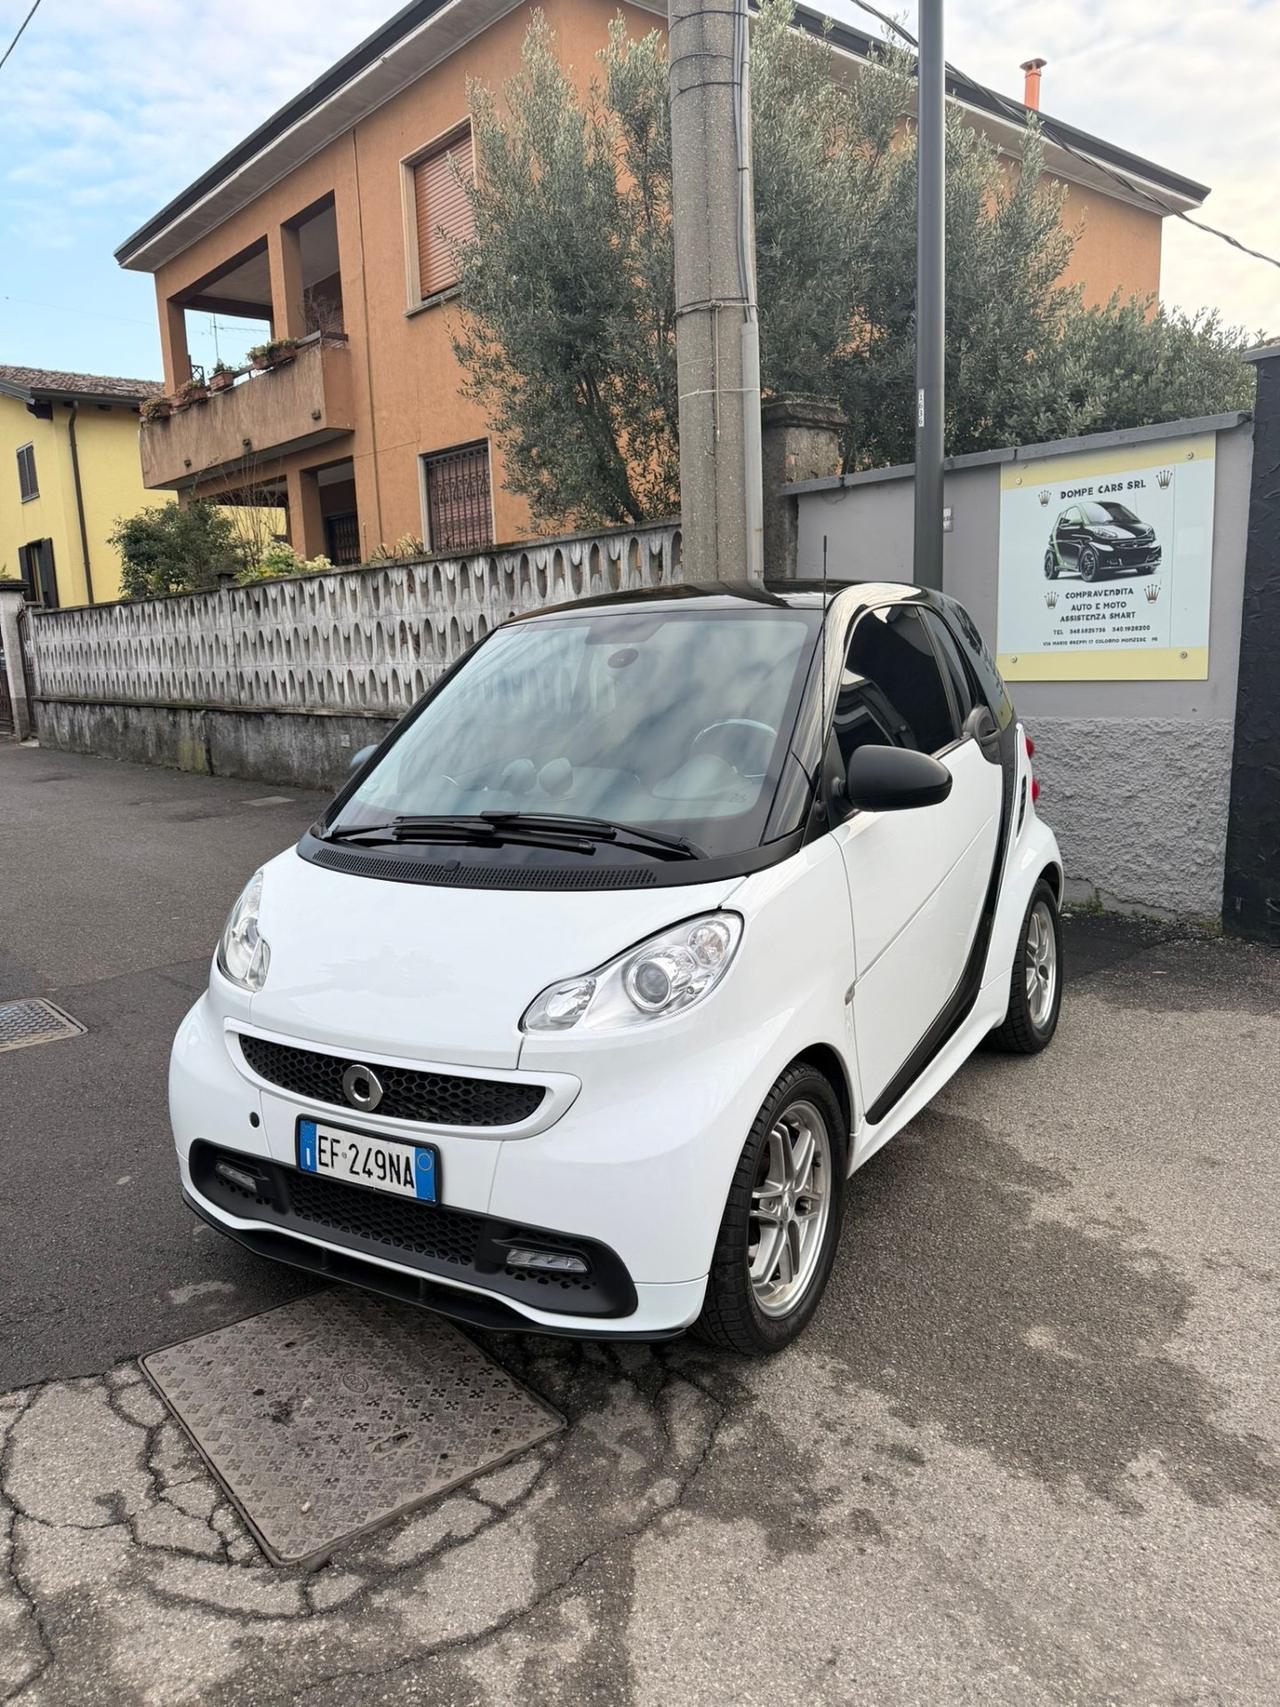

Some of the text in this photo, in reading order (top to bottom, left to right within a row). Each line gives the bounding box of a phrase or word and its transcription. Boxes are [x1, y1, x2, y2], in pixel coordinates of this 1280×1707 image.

[1060, 480, 1146, 499] DOMPE CARS SRL
[1065, 588, 1134, 599] COMPRAVENDITA
[1071, 603, 1092, 611] AUTO
[1103, 601, 1127, 610] MOTO
[1060, 611, 1136, 622] ASSISTENZA SMART
[318, 1135, 341, 1168] EF
[348, 1143, 415, 1189] 249NA
